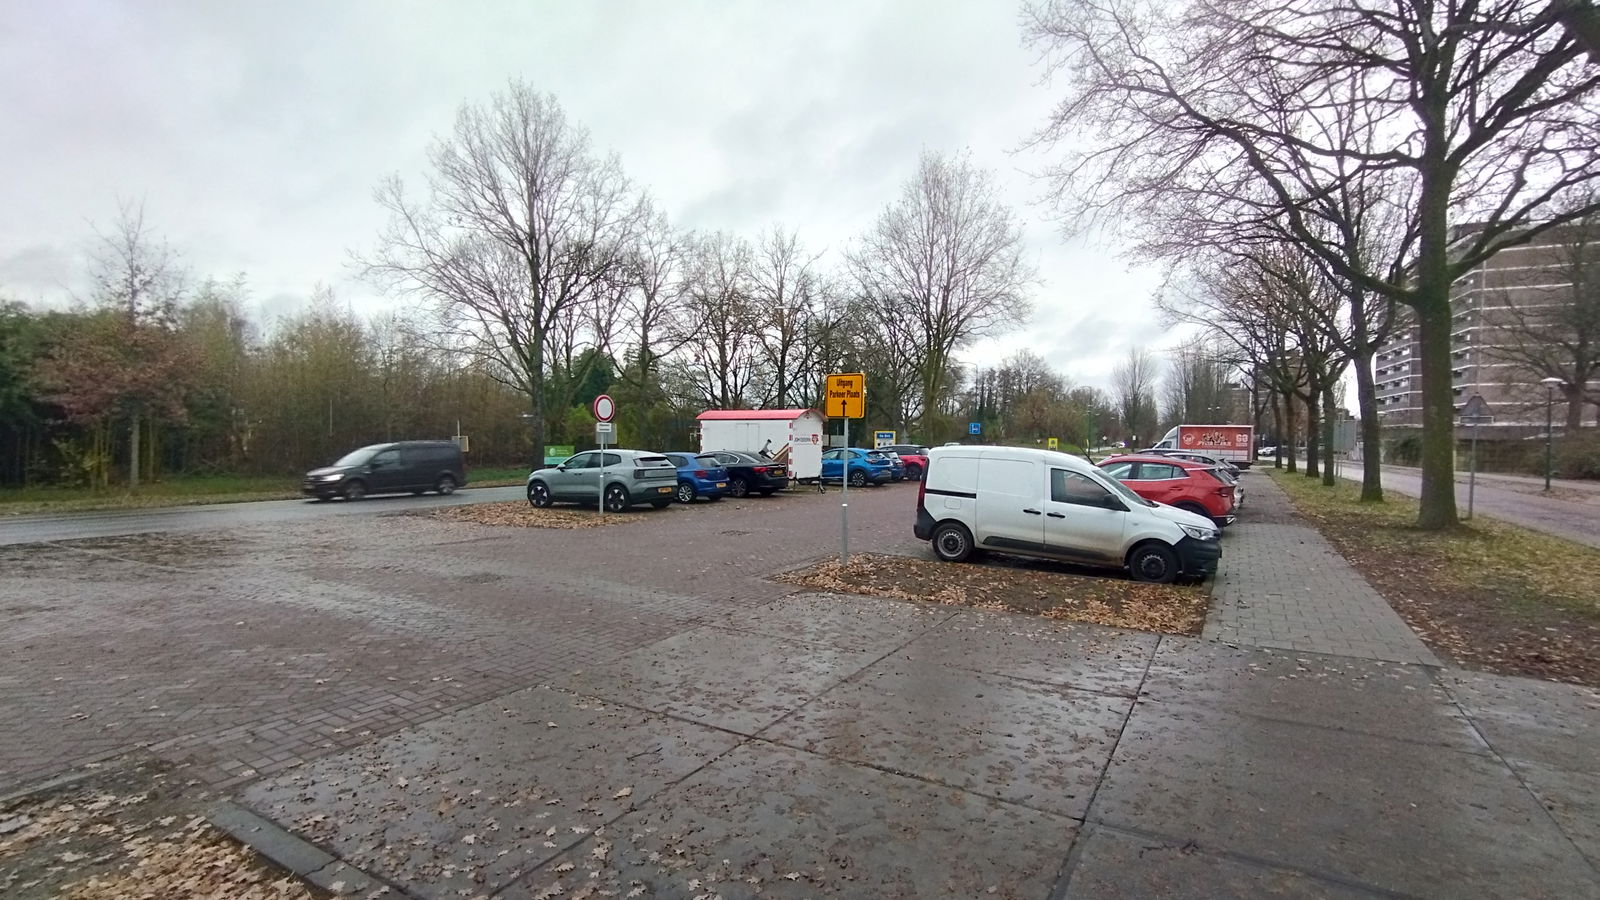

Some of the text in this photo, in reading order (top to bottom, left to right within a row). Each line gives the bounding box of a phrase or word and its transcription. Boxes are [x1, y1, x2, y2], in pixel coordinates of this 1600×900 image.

[836, 378, 853, 389] Uitgang
[829, 390, 860, 398] Parkeer Plaats
